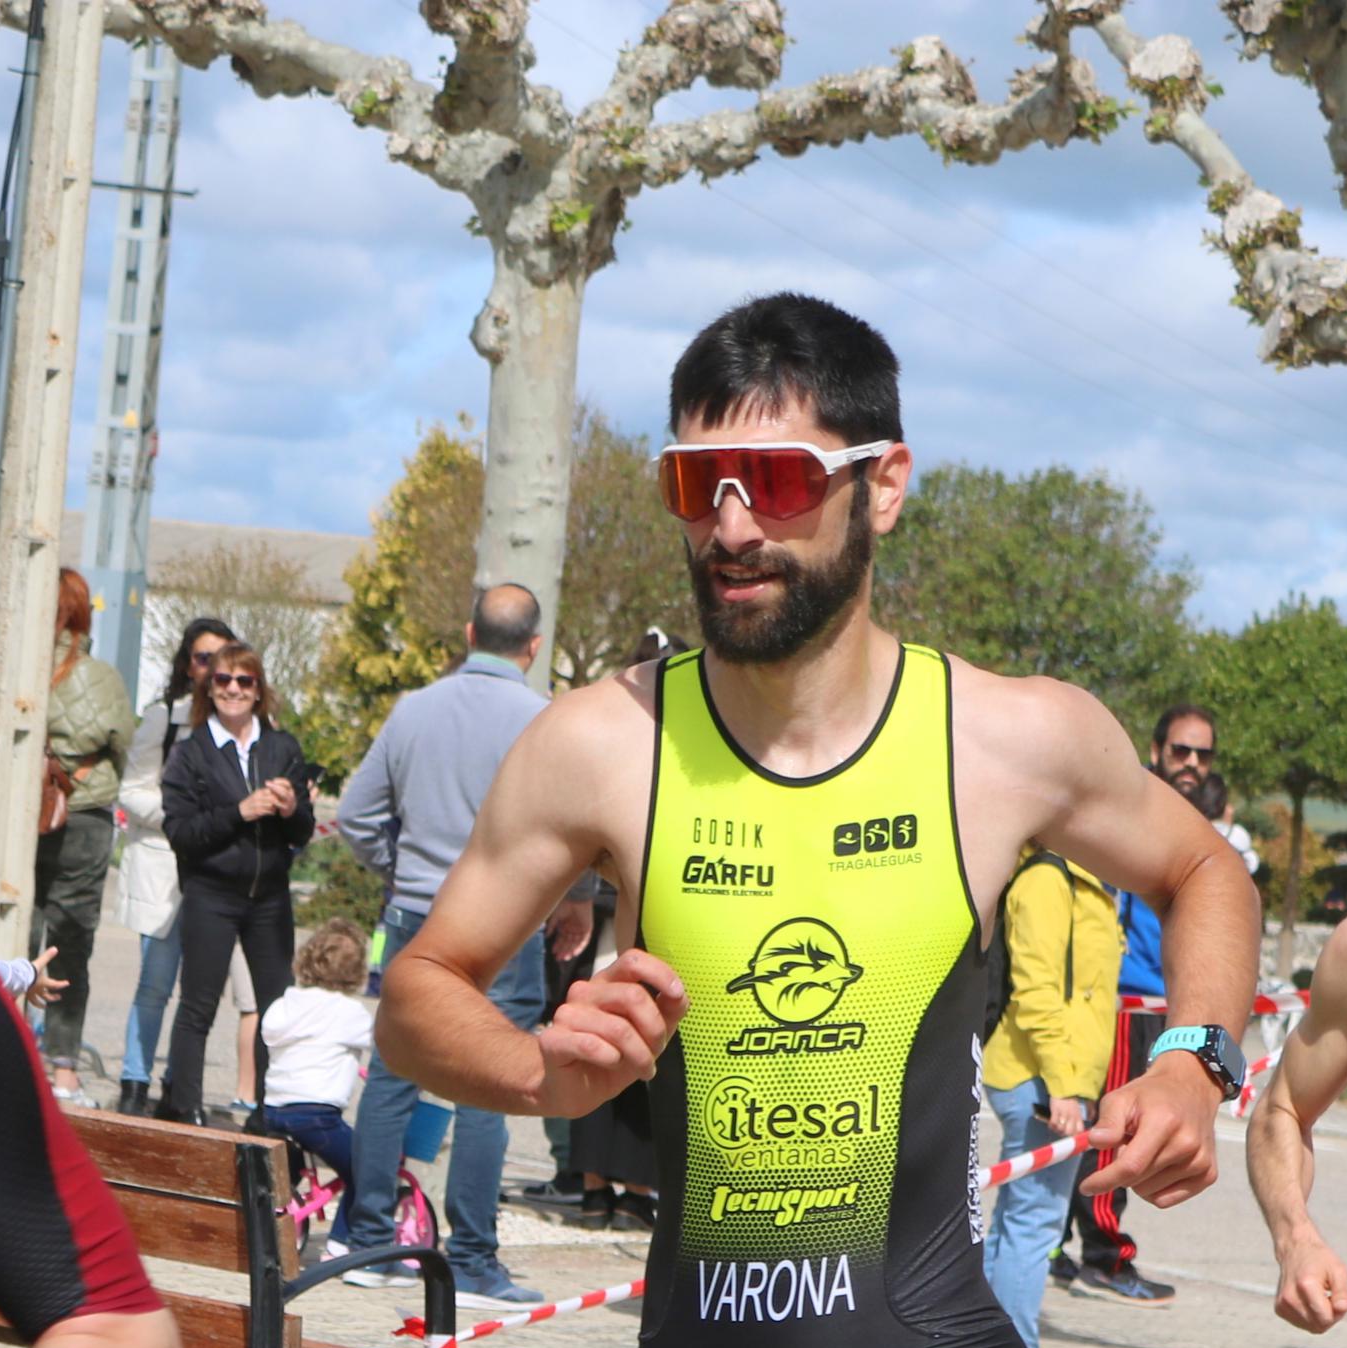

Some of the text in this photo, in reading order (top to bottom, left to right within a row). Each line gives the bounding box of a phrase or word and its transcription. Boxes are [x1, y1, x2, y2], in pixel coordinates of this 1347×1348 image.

[693, 817, 764, 848] GOBIK
[682, 855, 775, 887] GARFU
[827, 853, 923, 873] TRAGALEGUAS
[728, 1025, 864, 1054] JOANCA
[728, 1085, 881, 1142] itesal
[725, 1145, 852, 1169] ventanas
[698, 1254, 856, 1321] VARONA
